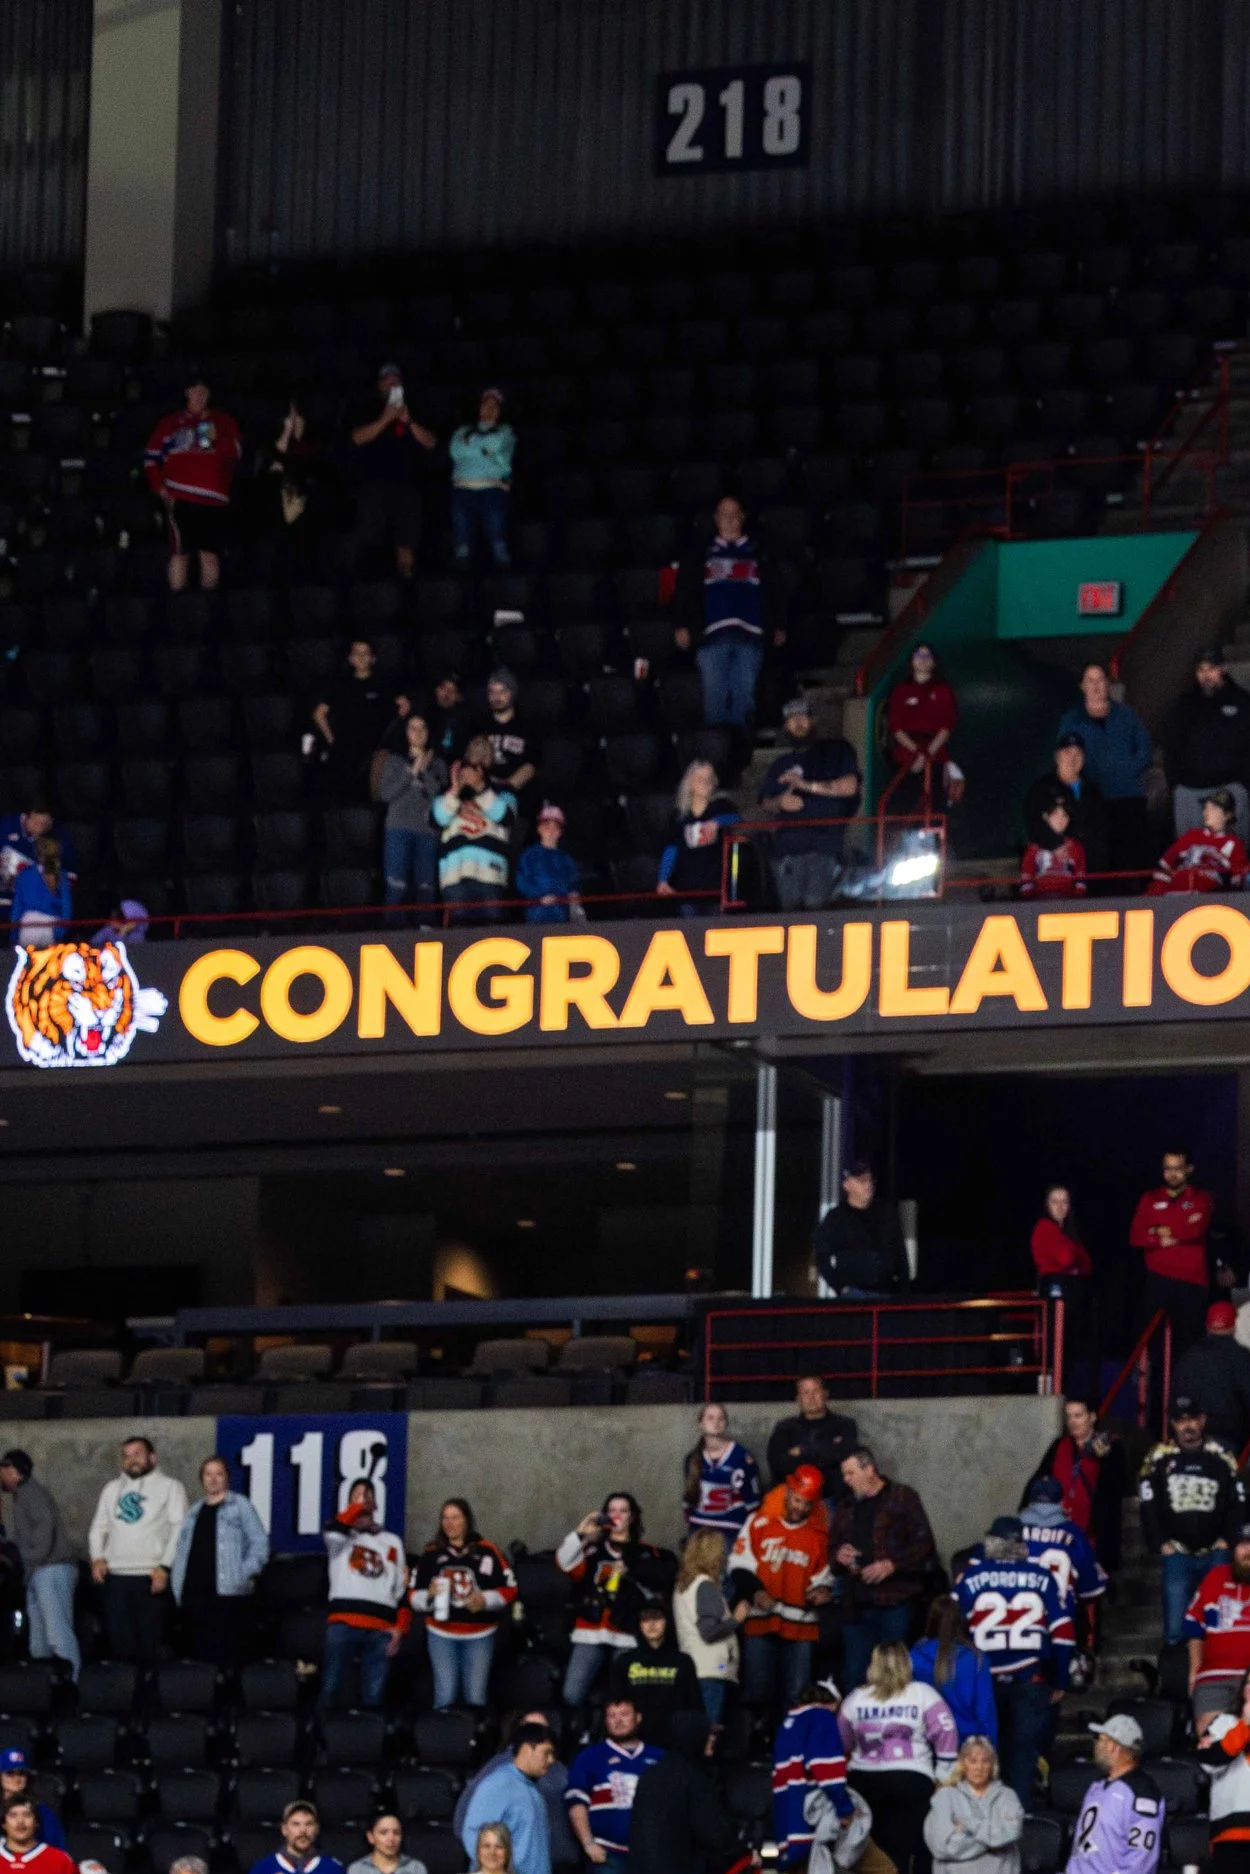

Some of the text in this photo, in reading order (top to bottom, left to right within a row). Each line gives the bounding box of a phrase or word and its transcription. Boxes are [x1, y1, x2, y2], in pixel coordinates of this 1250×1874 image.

[666, 76, 802, 162] 218
[241, 1431, 388, 1535] 118
[974, 1592, 1043, 1650] 22
[1128, 1826, 1156, 1850] 20
